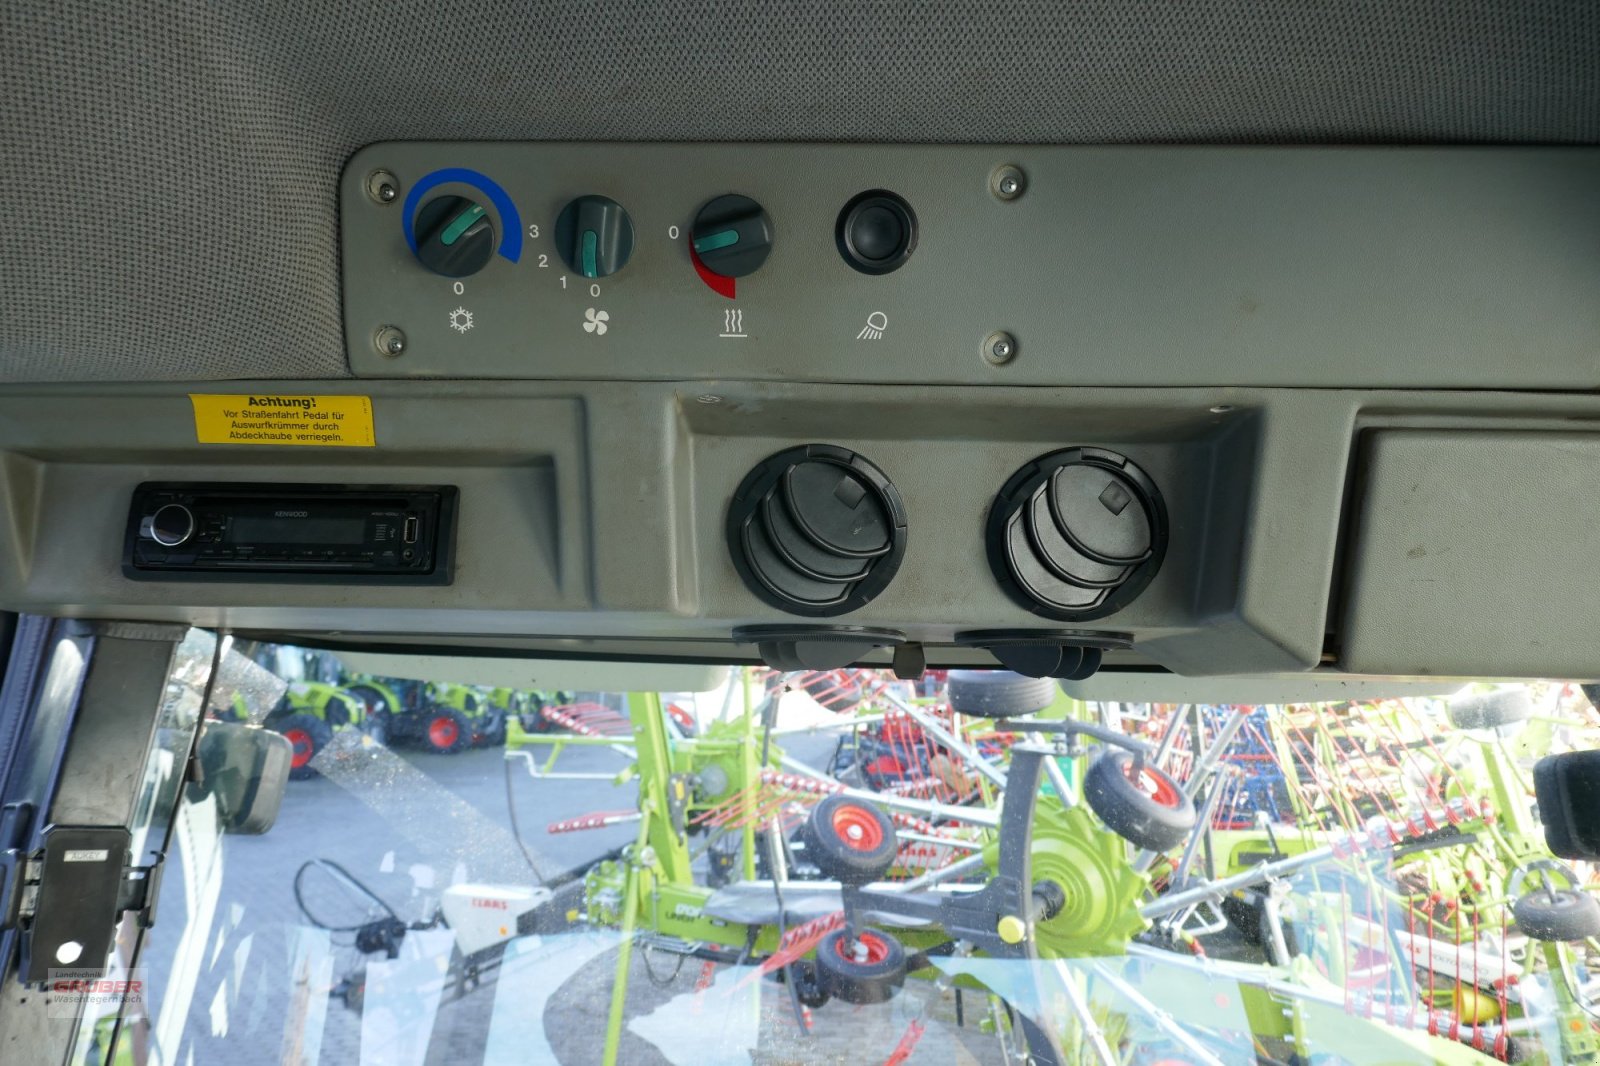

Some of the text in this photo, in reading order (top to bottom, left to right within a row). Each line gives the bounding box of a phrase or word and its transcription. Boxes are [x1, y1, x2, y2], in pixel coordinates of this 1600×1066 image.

[529, 225, 540, 239] 3
[668, 225, 680, 240] 0
[538, 254, 549, 268] 2
[453, 281, 464, 295] 0
[559, 275, 568, 289] 1
[589, 283, 601, 298] 0
[248, 396, 317, 410] Achtung!
[223, 409, 345, 420] Vor Straßenfahrt Pedal für
[231, 420, 339, 430] Auswurfkrümmer durch
[229, 430, 344, 443] Abdeckhaube verriegeln.
